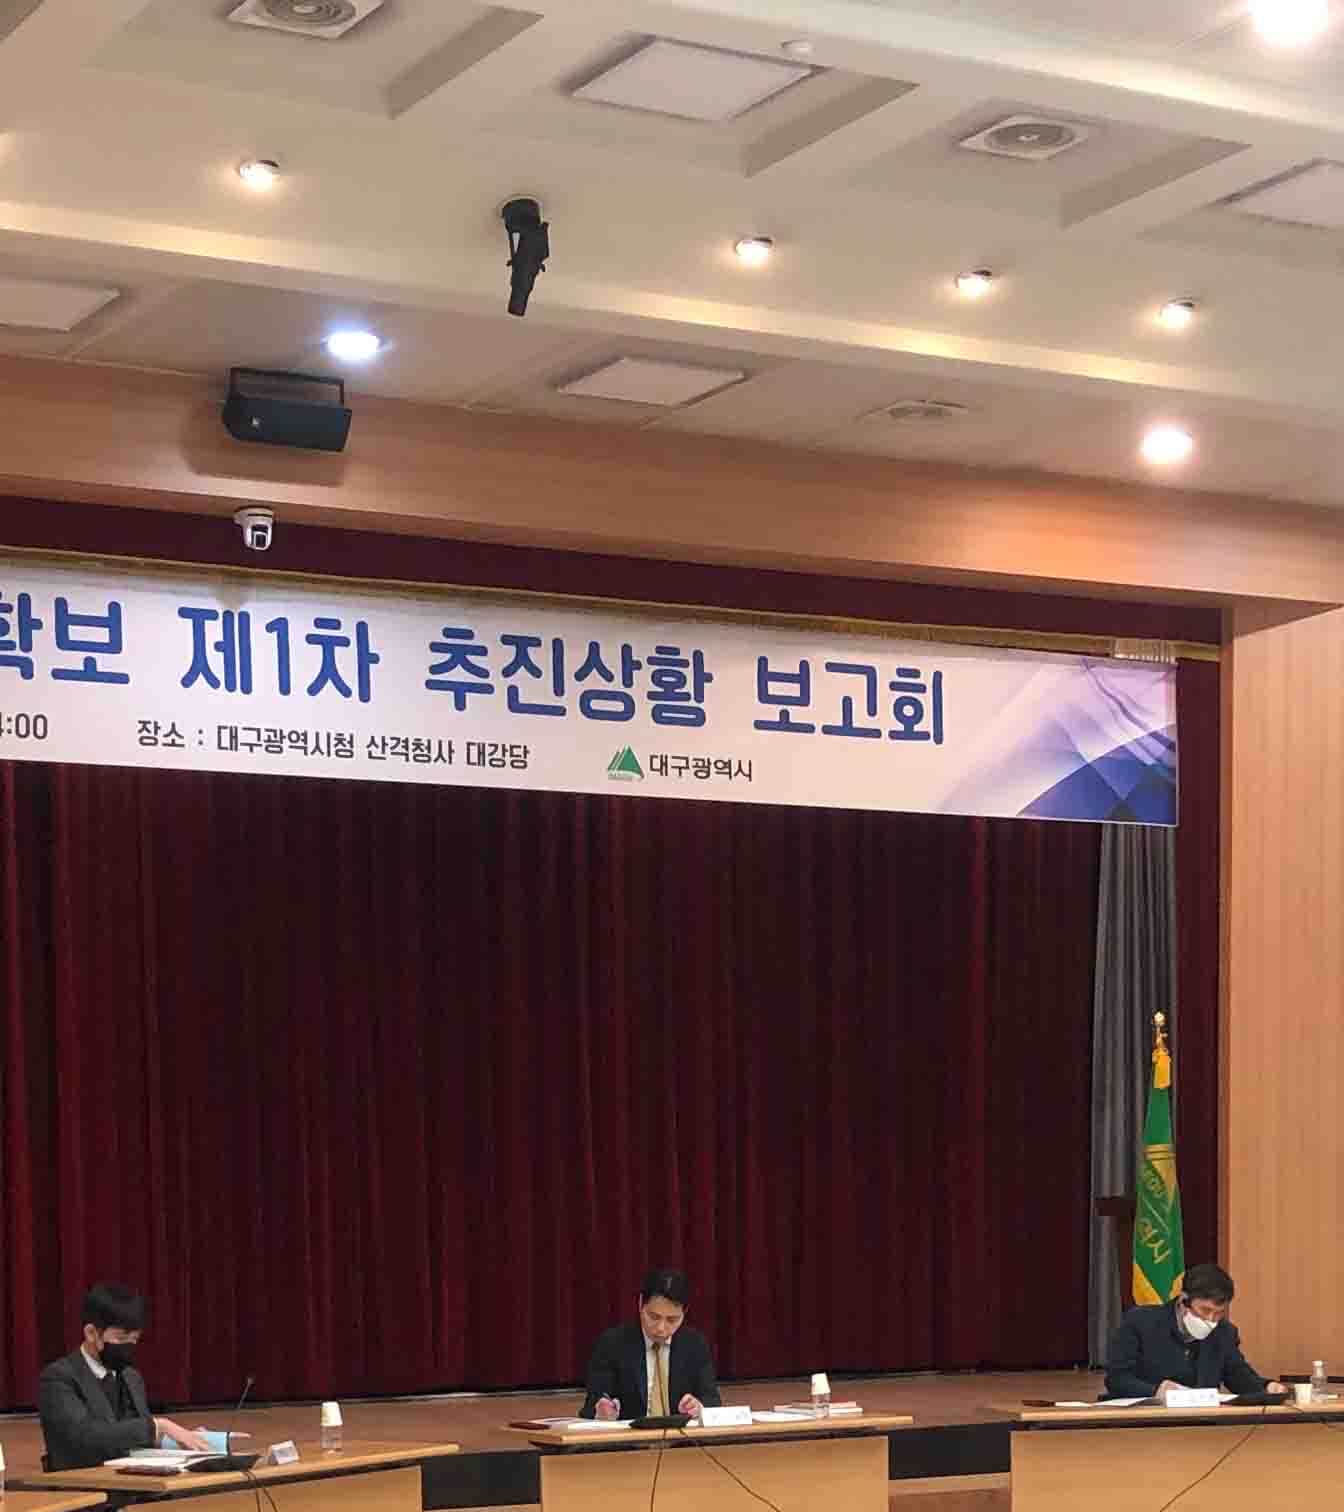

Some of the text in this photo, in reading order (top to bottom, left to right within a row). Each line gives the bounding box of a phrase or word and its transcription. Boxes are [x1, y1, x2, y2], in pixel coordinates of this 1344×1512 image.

[175, 605, 382, 704] 제1차
[424, 625, 714, 728] 추진상황
[753, 654, 946, 746] 보고회
[136, 719, 186, 749] 장소
[215, 724, 356, 760] 대구광역시청
[364, 734, 456, 766] 산격청사
[465, 741, 532, 771] 대강당
[648, 752, 754, 783] 대구광역시
